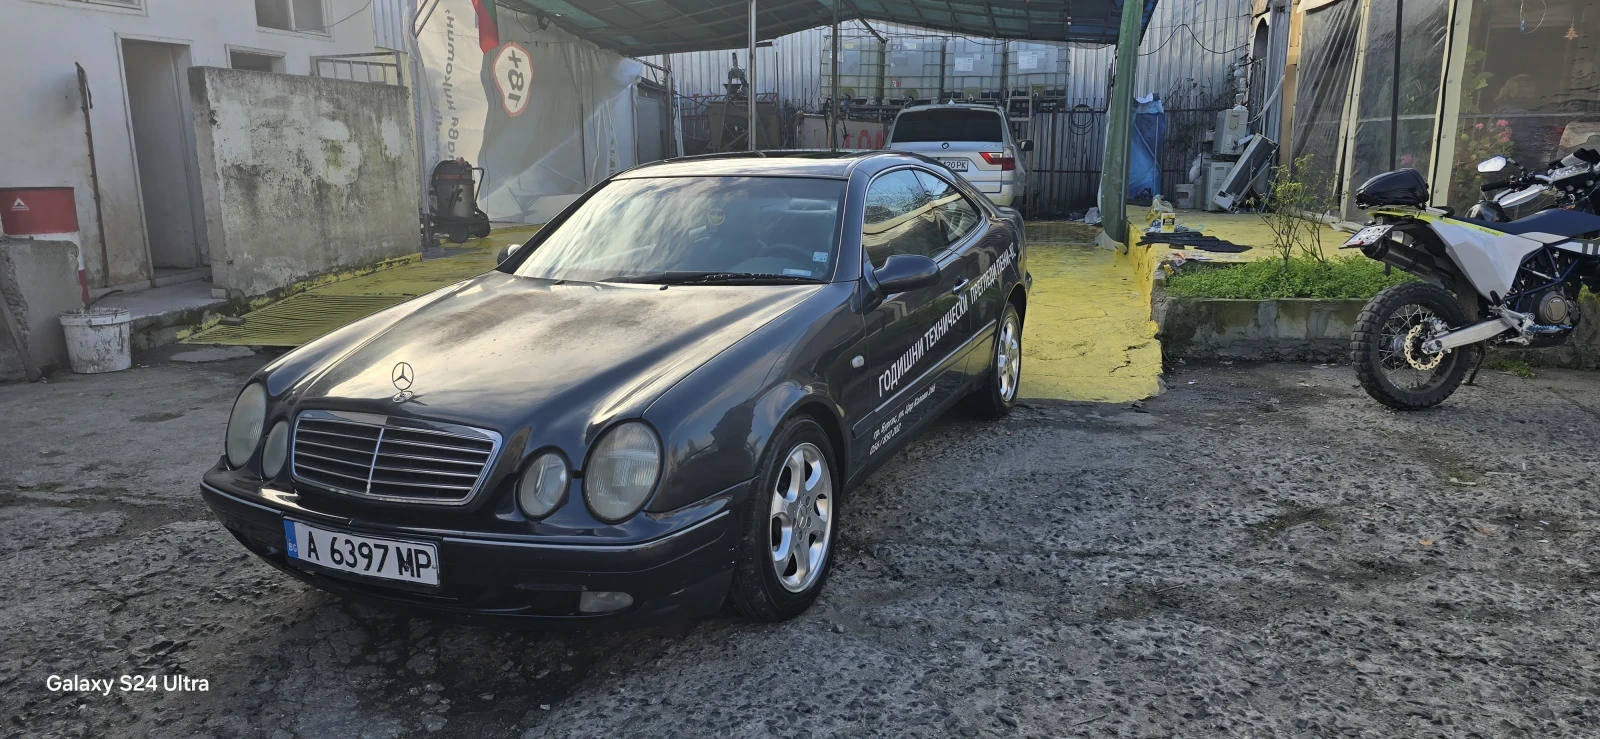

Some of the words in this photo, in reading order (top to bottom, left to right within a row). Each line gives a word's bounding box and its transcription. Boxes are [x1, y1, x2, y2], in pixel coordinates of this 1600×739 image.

[957, 160, 967, 169] PK
[878, 337, 924, 397] ГОДИШНИ
[924, 294, 969, 351] ТЕХНИЧЕСКИ
[970, 262, 998, 305] ПРЕГЛЕДИ
[288, 543, 298, 553] BG
[307, 530, 320, 561] A
[329, 536, 390, 573] 6397
[395, 546, 432, 578] MP
